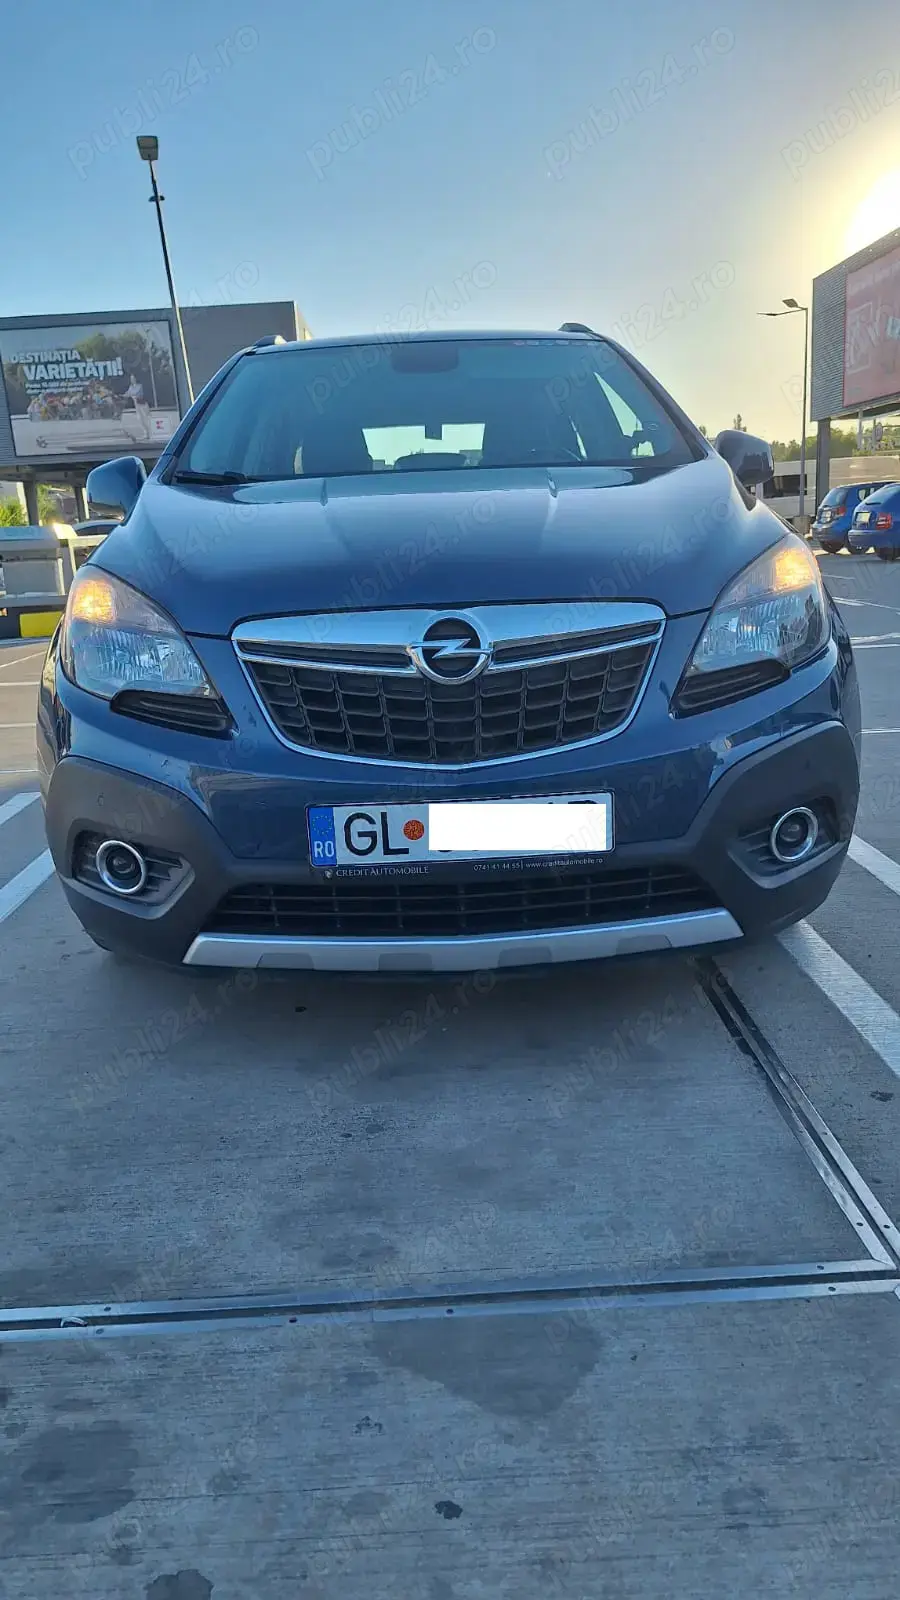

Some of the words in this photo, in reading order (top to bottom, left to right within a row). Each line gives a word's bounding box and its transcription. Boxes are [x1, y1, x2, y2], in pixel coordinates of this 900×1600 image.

[343, 811, 410, 857] GL
[314, 840, 335, 858] RO
[335, 868, 369, 878] CREDIT
[370, 866, 430, 877] AUTOMOBILE
